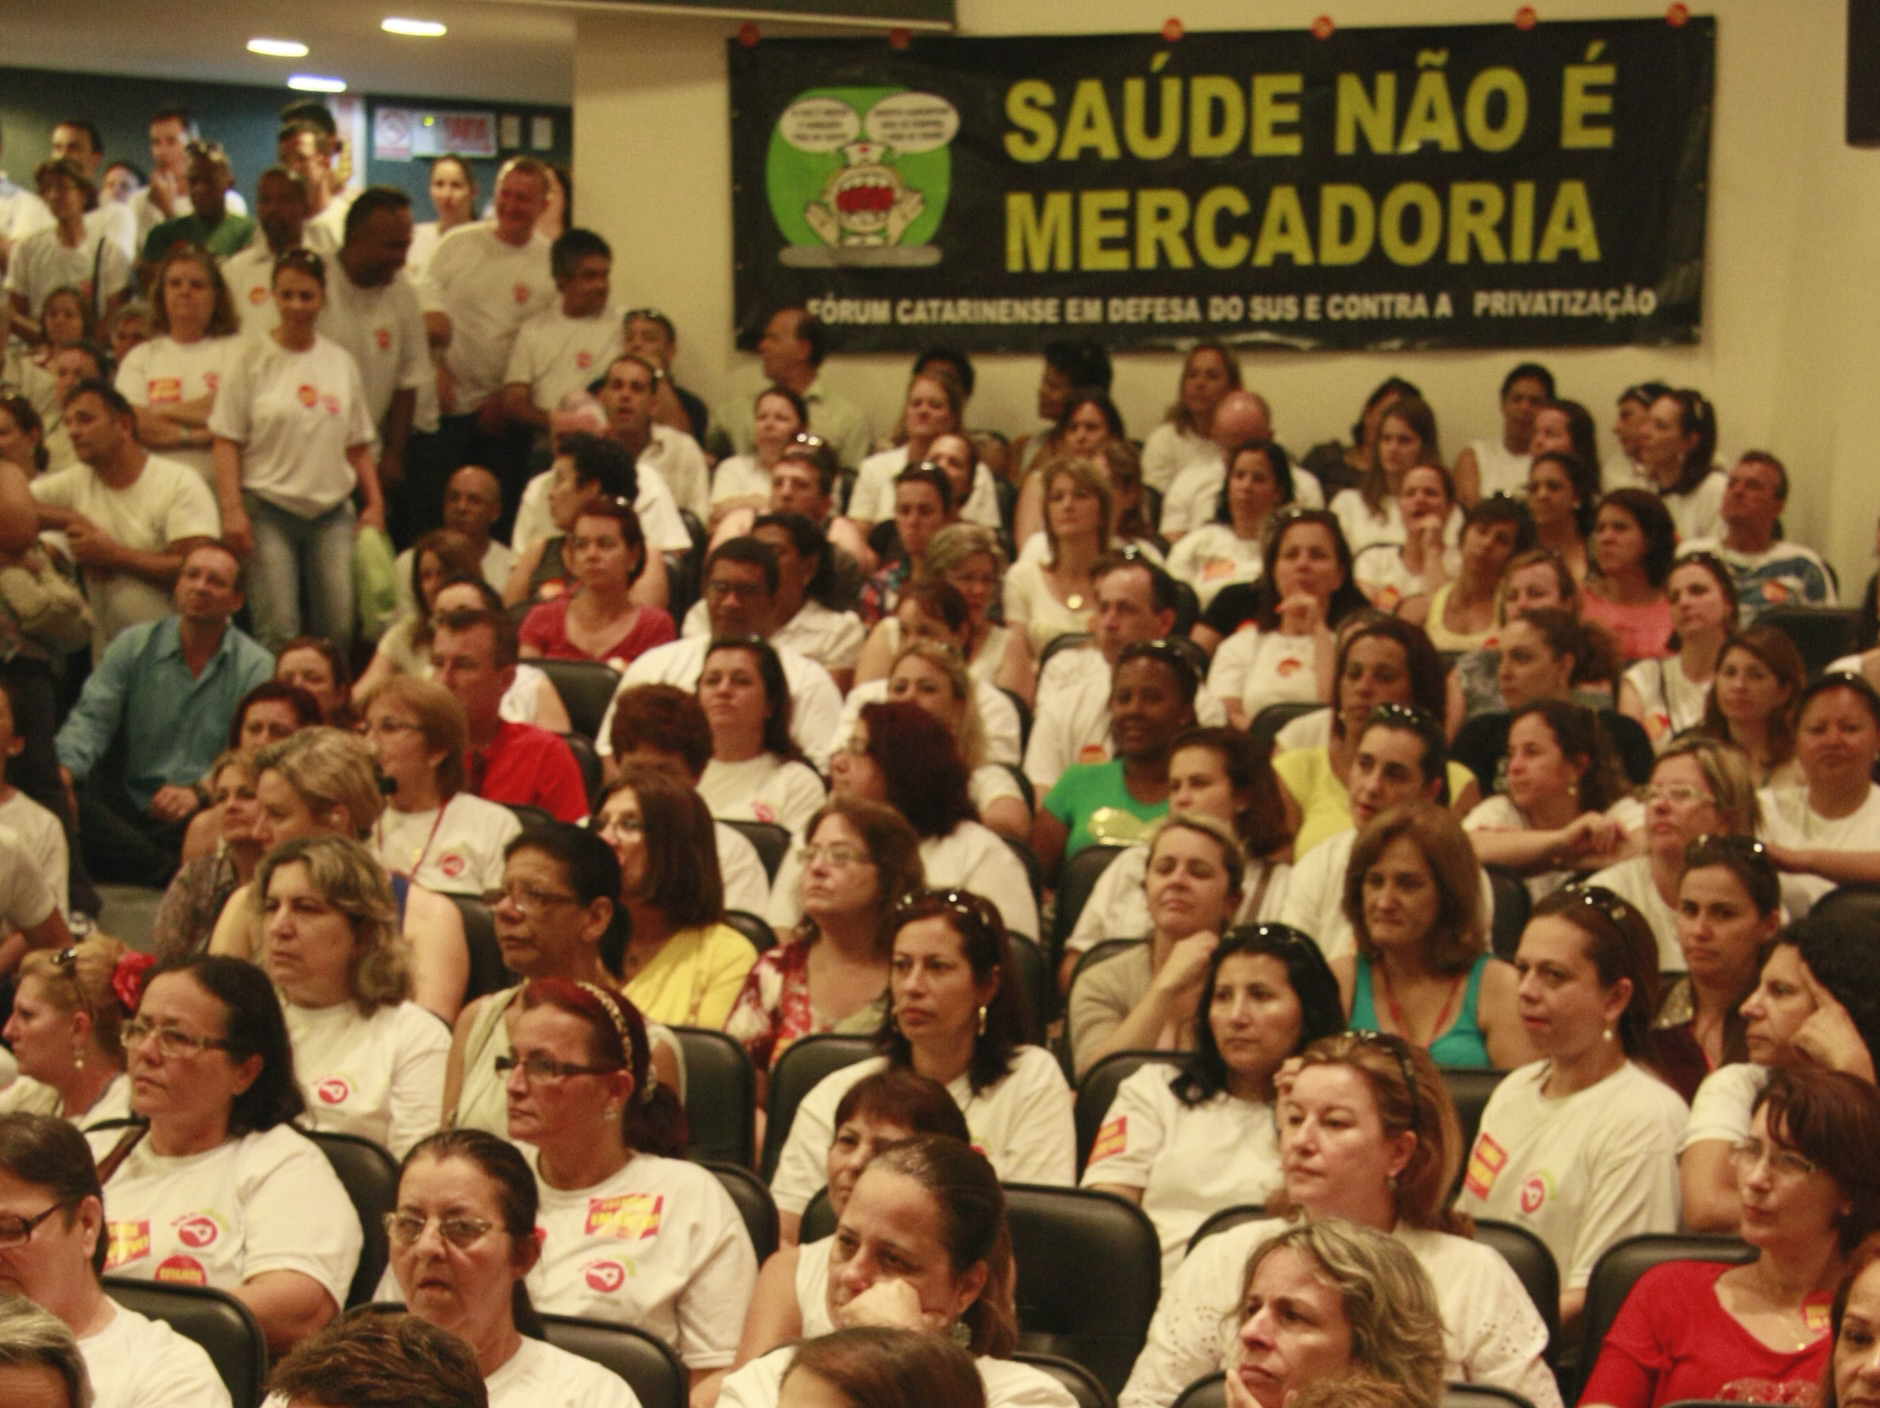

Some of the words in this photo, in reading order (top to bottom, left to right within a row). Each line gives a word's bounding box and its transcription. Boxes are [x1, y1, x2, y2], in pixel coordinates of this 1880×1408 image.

[1003, 50, 1303, 163] SAÚDE
[1335, 49, 1529, 155] NÃO
[1560, 41, 1617, 150] É
[1004, 180, 1602, 273] MERCADORIA
[897, 300, 1061, 325] CATARINENSE
[1065, 298, 1101, 324] EM
[1107, 297, 1201, 323] DEFESA
[1208, 296, 1244, 322] DO
[1248, 296, 1299, 321] SUS
[1303, 296, 1323, 320] E
[1325, 294, 1429, 320] CONTRA
[1432, 293, 1453, 318] A
[1472, 285, 1658, 322] PRIVATIZAÇÃO
